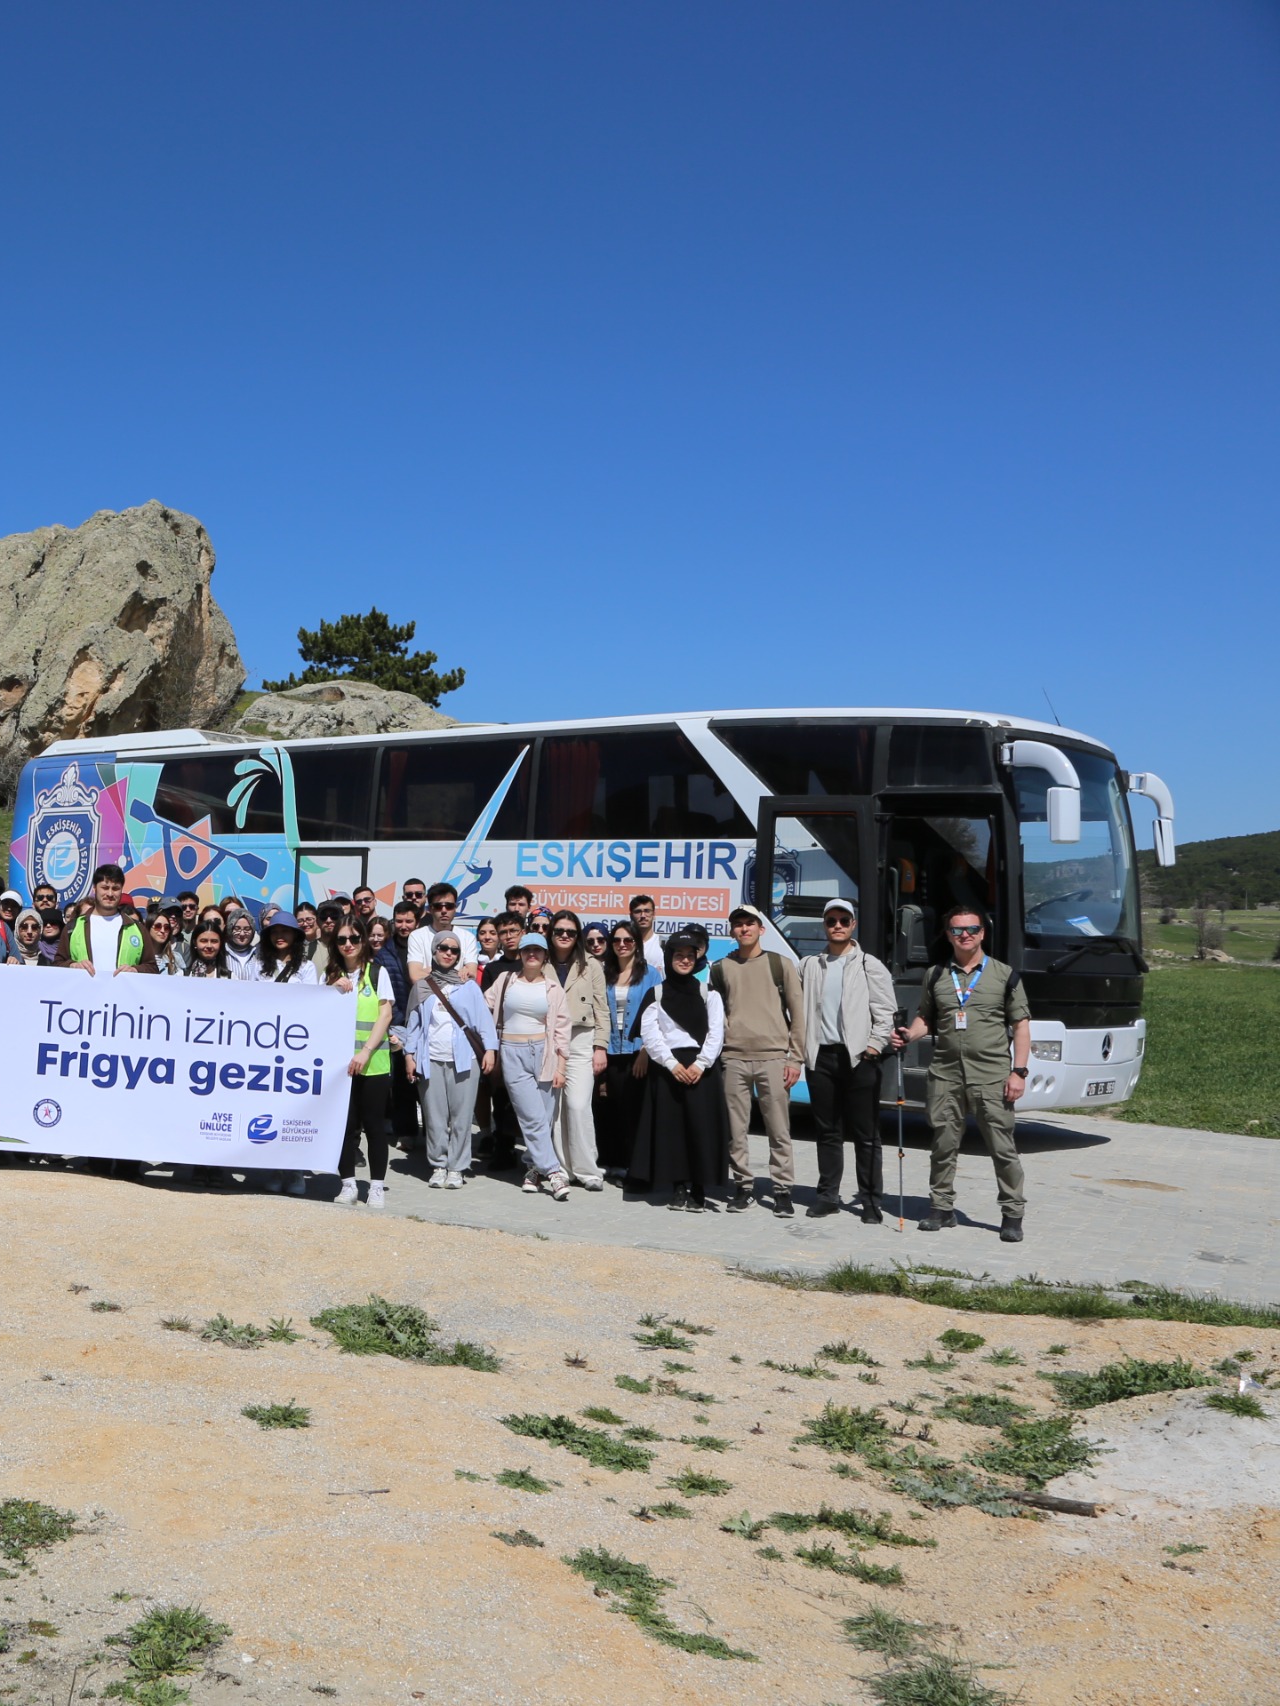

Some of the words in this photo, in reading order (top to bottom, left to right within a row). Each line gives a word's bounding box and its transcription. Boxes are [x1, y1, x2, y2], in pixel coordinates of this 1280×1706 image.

[46, 819, 82, 839] ESKİŞEHİR
[64, 847, 88, 901] BELEDİYESİ
[516, 841, 738, 882] ESKİŞEHİR
[40, 1000, 170, 1041] Tarihin
[185, 1009, 309, 1050] izinde
[36, 1042, 175, 1090] Frigya
[189, 1055, 323, 1095] gezisi
[200, 1120, 232, 1132] ÜNLÜCE
[212, 1112, 233, 1122] AYŞE
